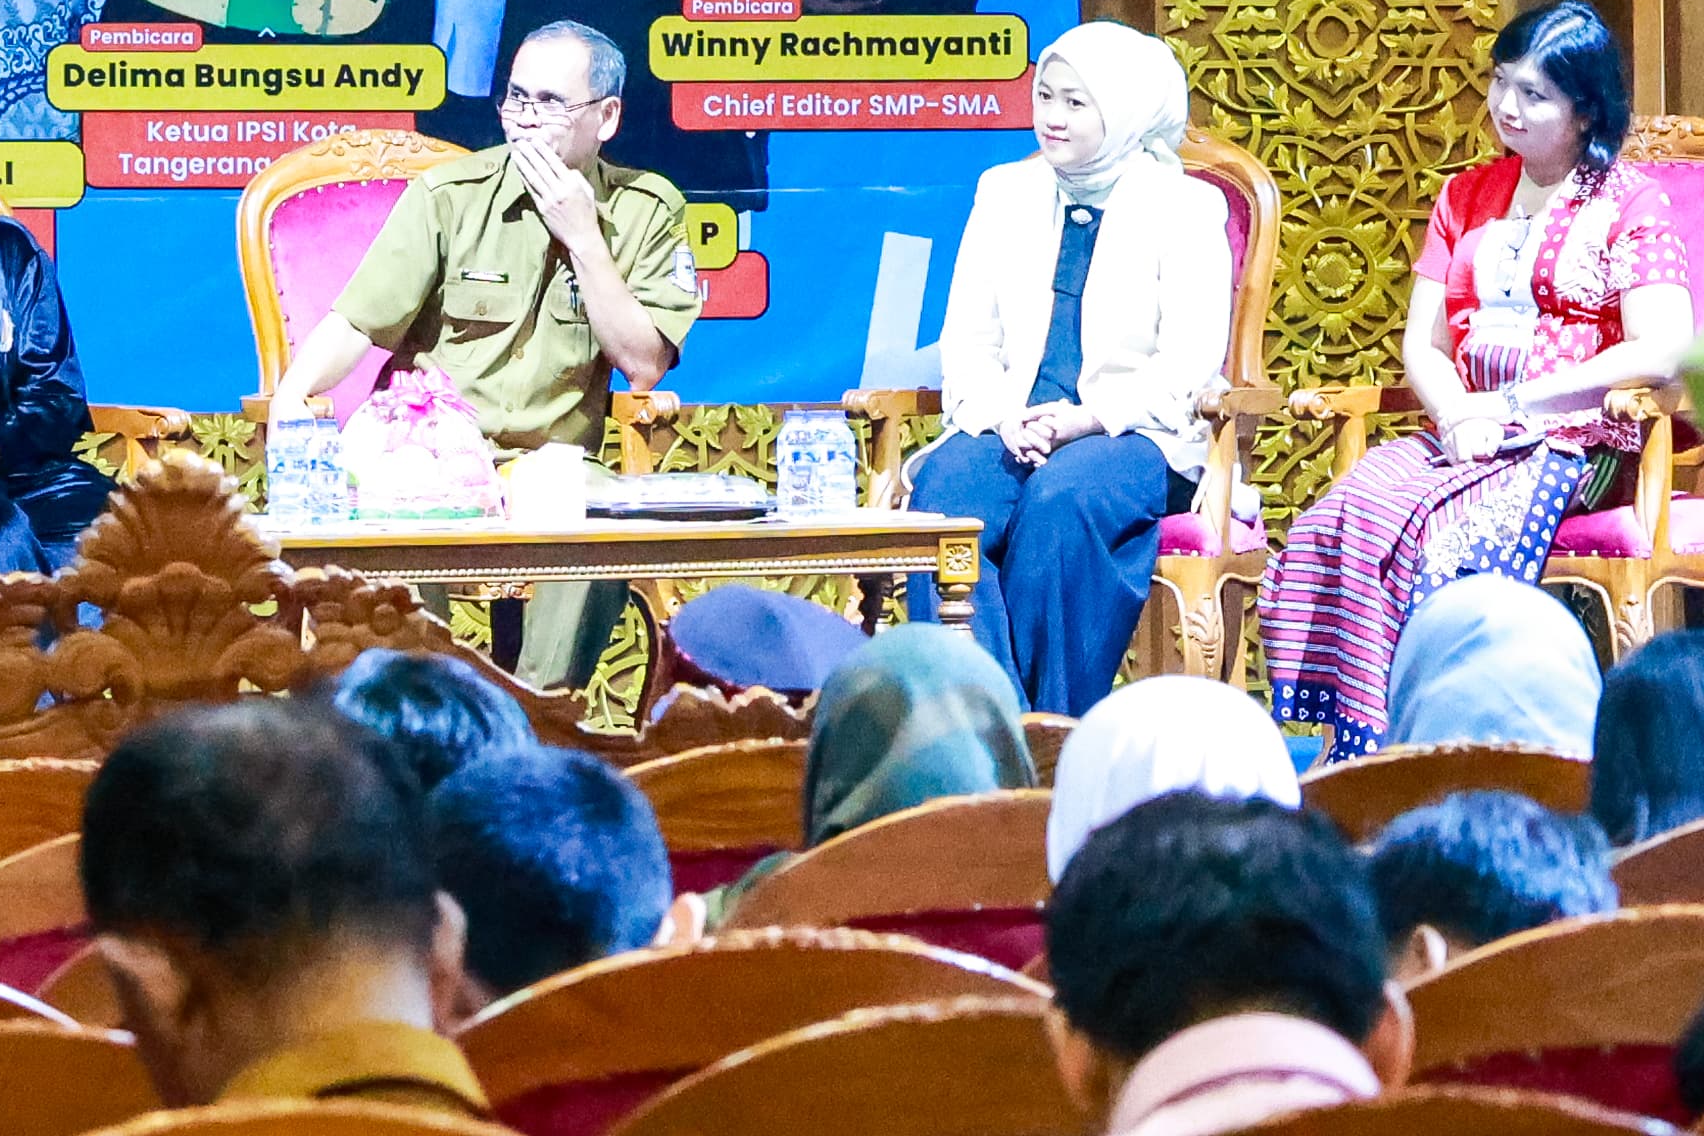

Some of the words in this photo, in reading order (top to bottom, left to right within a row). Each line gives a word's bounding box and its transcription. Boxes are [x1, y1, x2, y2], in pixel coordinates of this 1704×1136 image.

[691, 0, 794, 15] Pembicara
[89, 28, 194, 45] Pembicara
[661, 28, 771, 65] Winny
[780, 28, 1012, 65] Rachmayanti
[63, 61, 185, 88] Delima
[196, 63, 325, 96] Bungsu
[334, 63, 424, 96] Andy
[703, 94, 775, 117] Chief
[782, 94, 862, 117] Editor
[869, 94, 1001, 116] SMP-SMA
[147, 121, 229, 143] Ketua
[237, 121, 285, 143] IPSI
